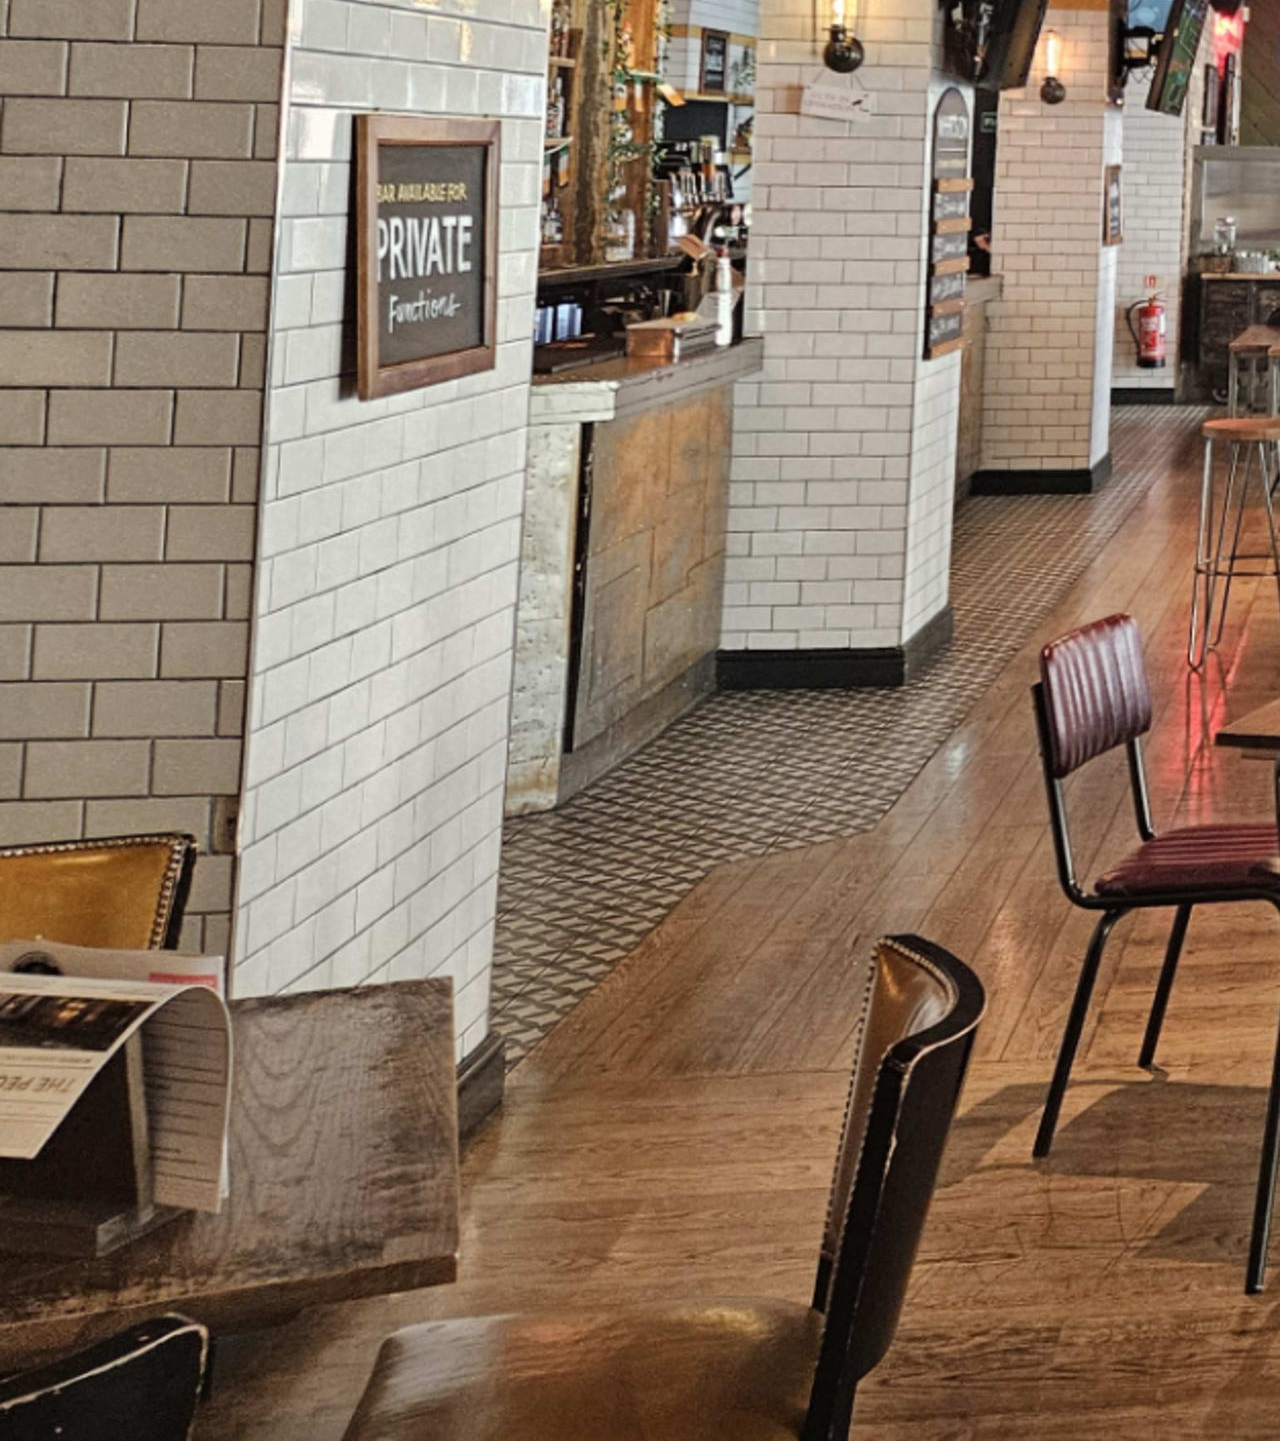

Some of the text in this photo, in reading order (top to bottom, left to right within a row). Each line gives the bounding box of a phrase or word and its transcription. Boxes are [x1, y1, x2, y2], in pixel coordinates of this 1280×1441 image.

[376, 182, 468, 203] BAR AVAILABLE FOR
[376, 214, 473, 284] PRIVATE
